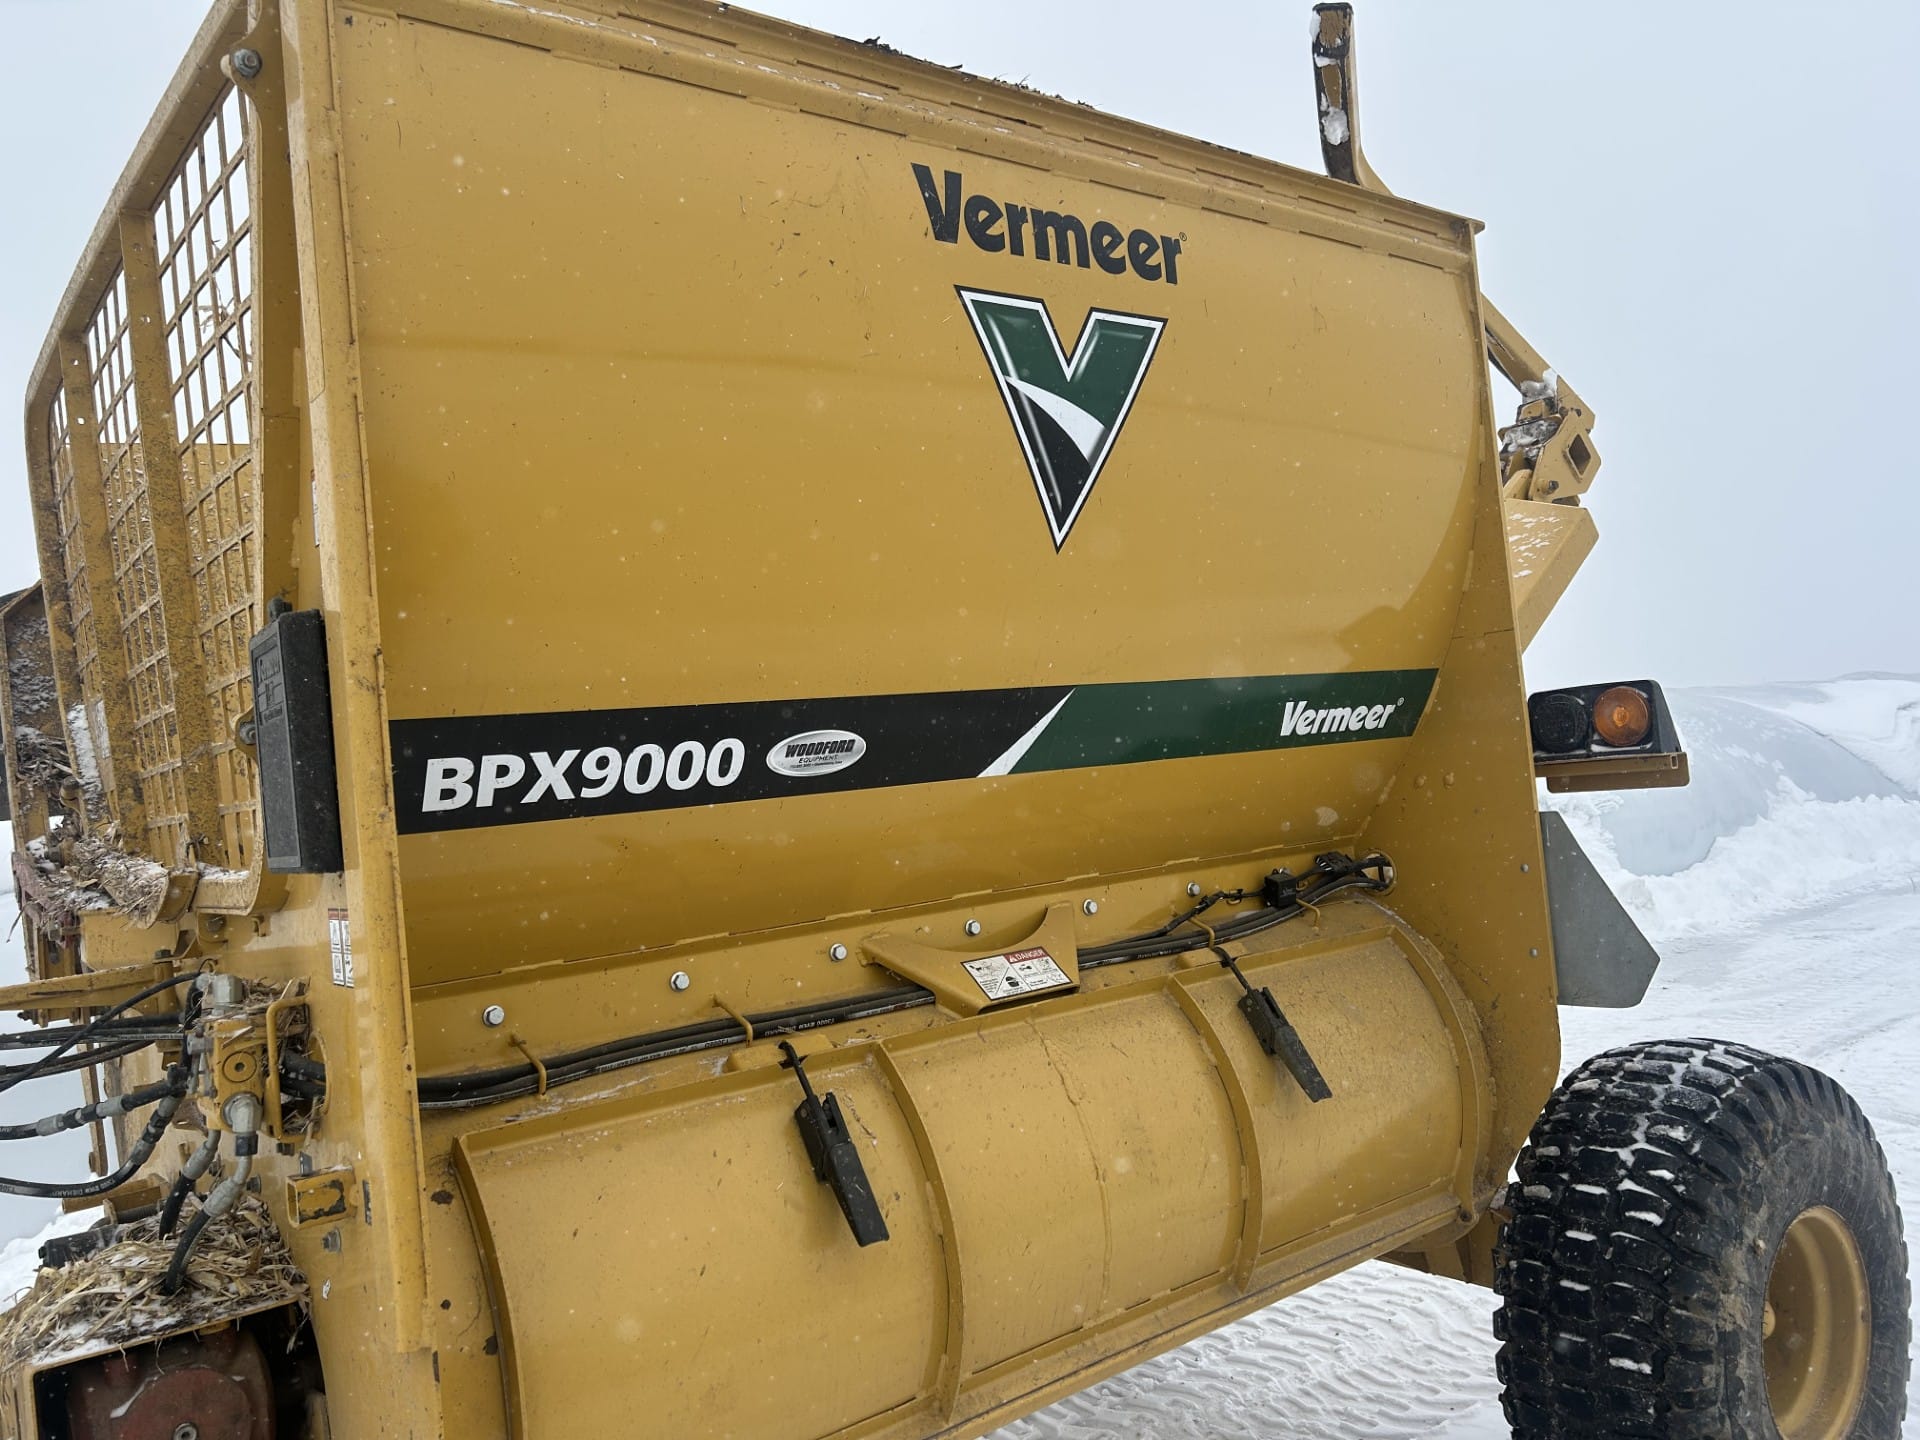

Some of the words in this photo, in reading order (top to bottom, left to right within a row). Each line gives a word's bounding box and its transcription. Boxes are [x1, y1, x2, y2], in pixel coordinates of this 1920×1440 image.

[911, 162, 1182, 284] Vermeer
[1280, 701, 1395, 736] Vermeer
[785, 739, 855, 757] WOODFORD
[798, 754, 839, 764] EQUIPMENT
[422, 738, 745, 812] BPX9000
[1016, 949, 1045, 960] DANGER
